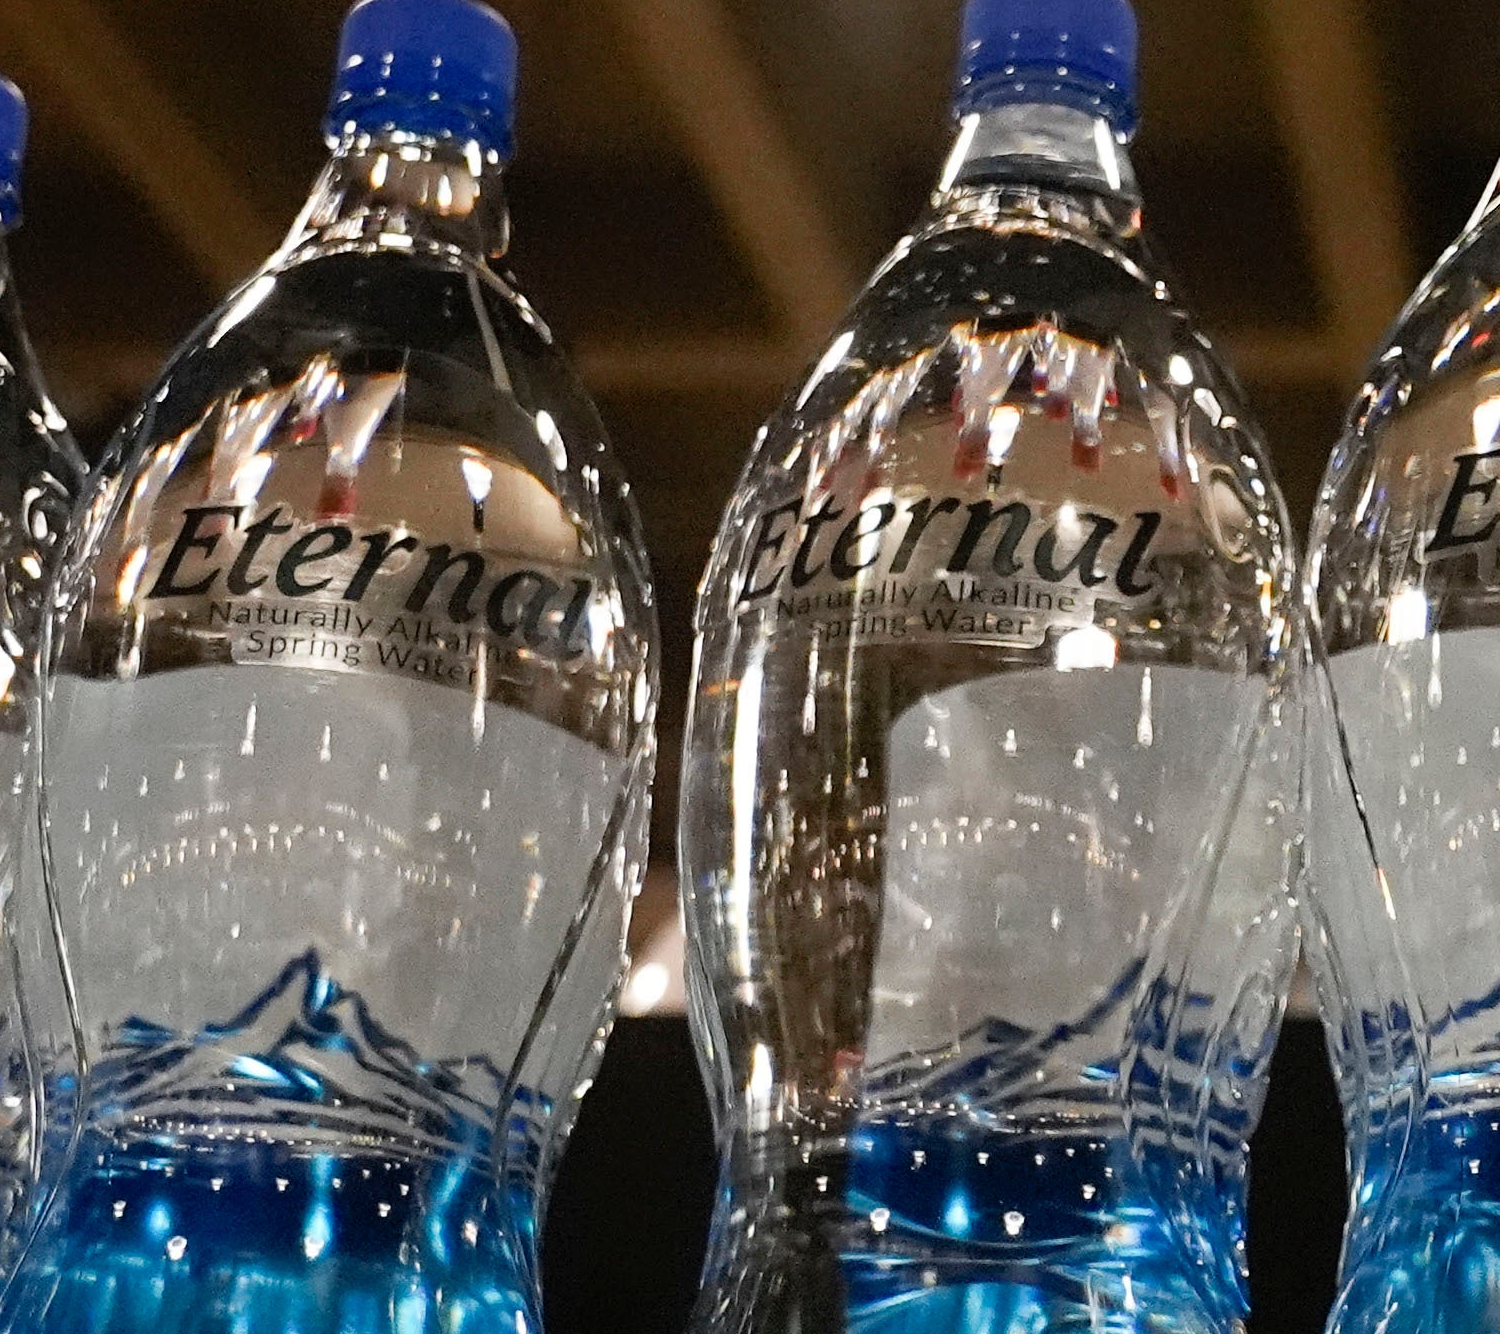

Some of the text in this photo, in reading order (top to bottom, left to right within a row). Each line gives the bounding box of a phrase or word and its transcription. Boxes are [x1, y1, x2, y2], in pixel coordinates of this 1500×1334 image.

[736, 495, 1162, 605] Eternal
[146, 505, 591, 658] Eternal
[777, 580, 1075, 618] Naturally Alkaline
[209, 603, 374, 637] Naturally
[922, 609, 1033, 636] Water
[247, 631, 360, 666] Spring
